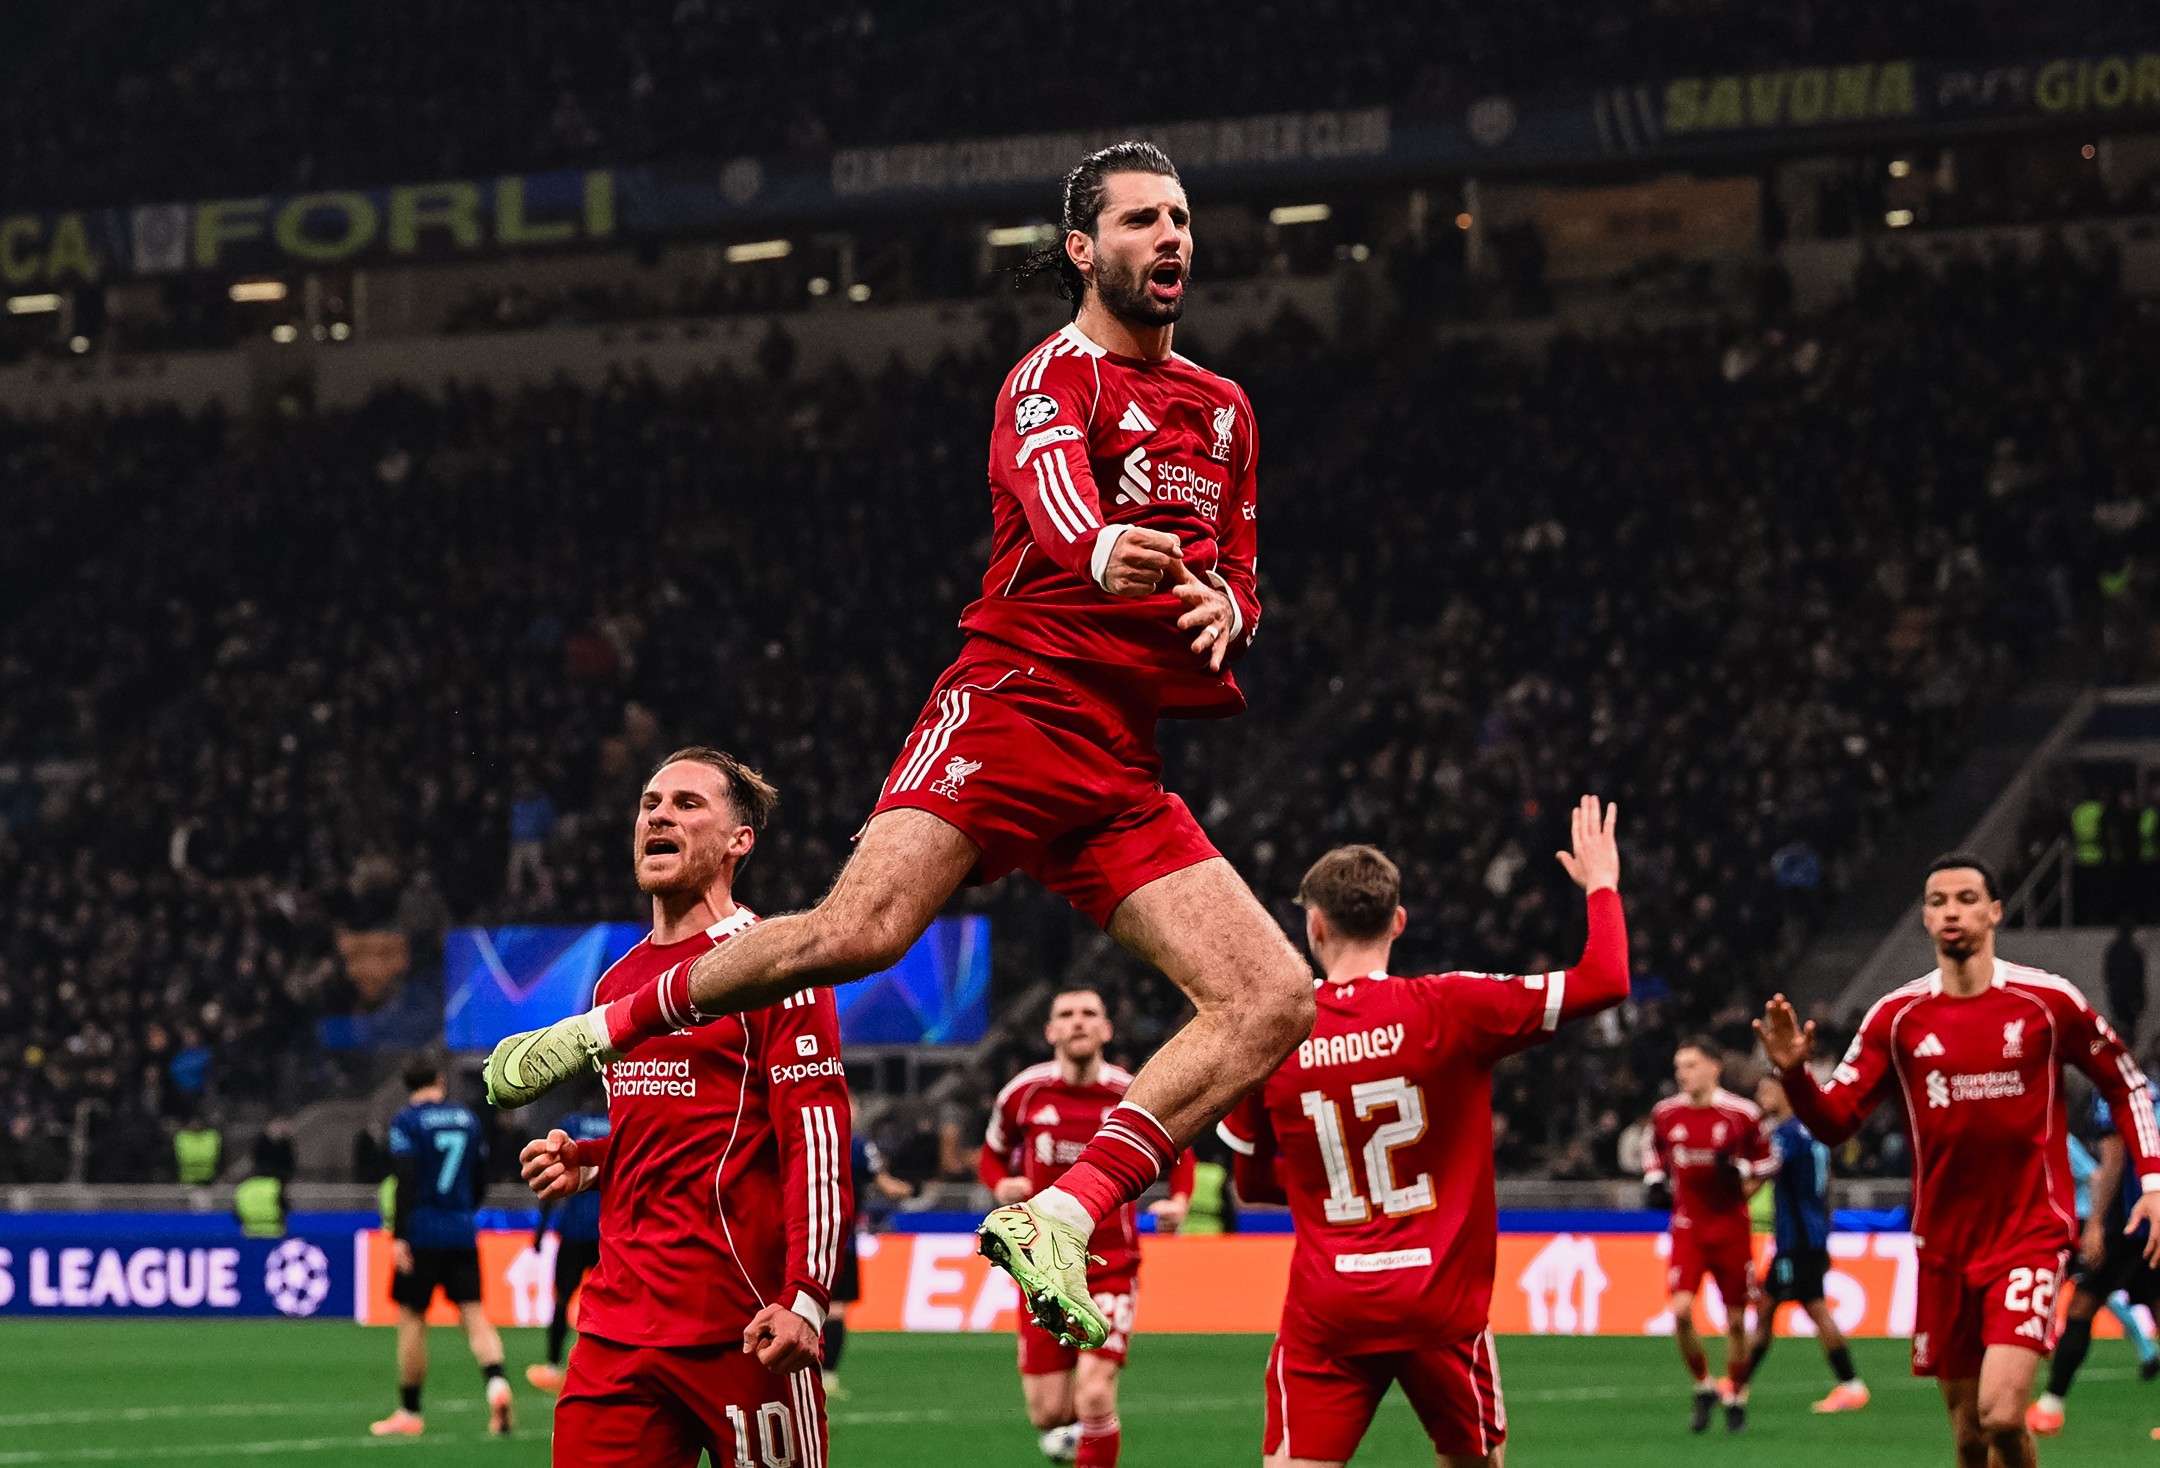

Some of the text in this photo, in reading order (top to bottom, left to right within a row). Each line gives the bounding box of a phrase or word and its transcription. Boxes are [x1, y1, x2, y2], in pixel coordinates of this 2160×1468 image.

[1664, 61, 1918, 132] SAVONA
[195, 170, 615, 269] FORLI
[612, 1058, 689, 1078] standard
[1299, 1023, 1404, 1069] BRADLEY
[613, 1077, 696, 1097] chartered
[434, 1129, 468, 1195] 7
[1301, 1076, 1436, 1225] 12
[29, 1247, 241, 1307] LEAGUE
[2004, 1266, 2055, 1319] 22
[726, 1401, 795, 1468] 10
